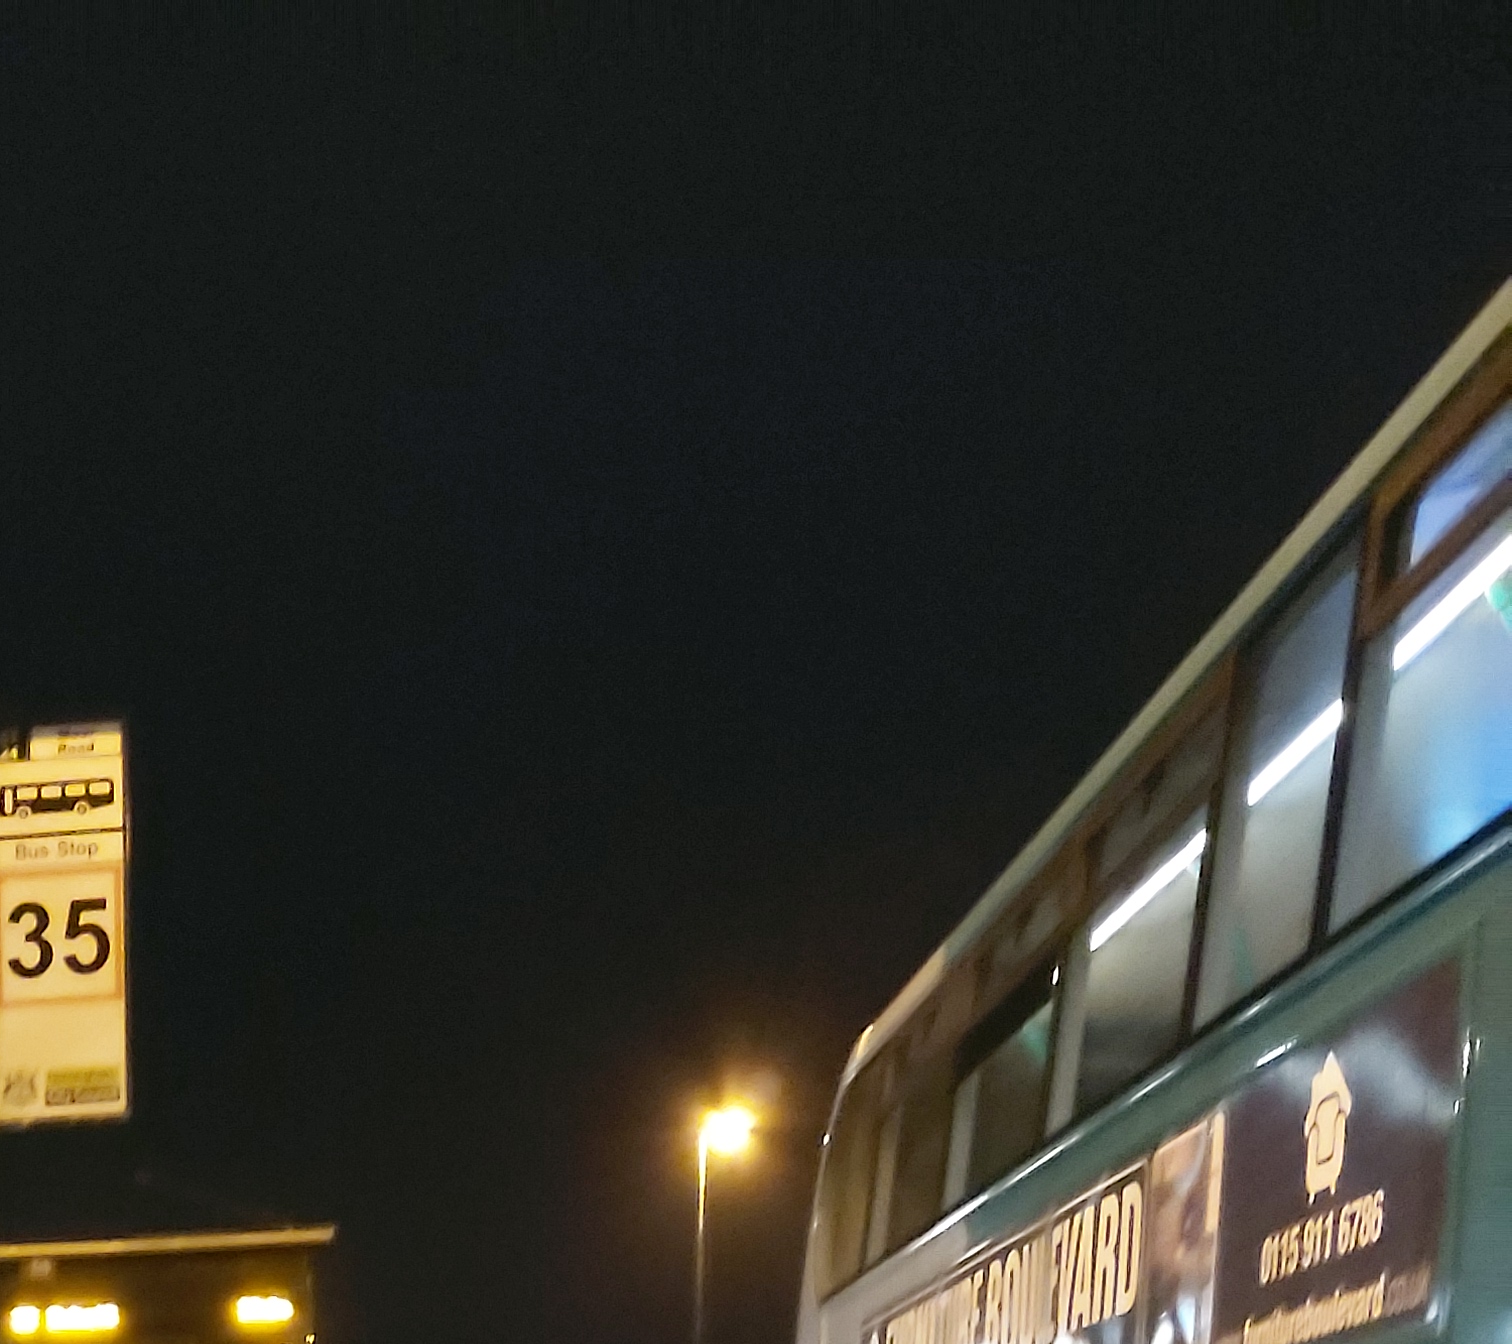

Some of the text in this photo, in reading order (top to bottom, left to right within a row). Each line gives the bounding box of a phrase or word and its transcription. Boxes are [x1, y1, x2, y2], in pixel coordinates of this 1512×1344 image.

[15, 841, 99, 861] Bus Stop
[8, 898, 111, 979] 35
